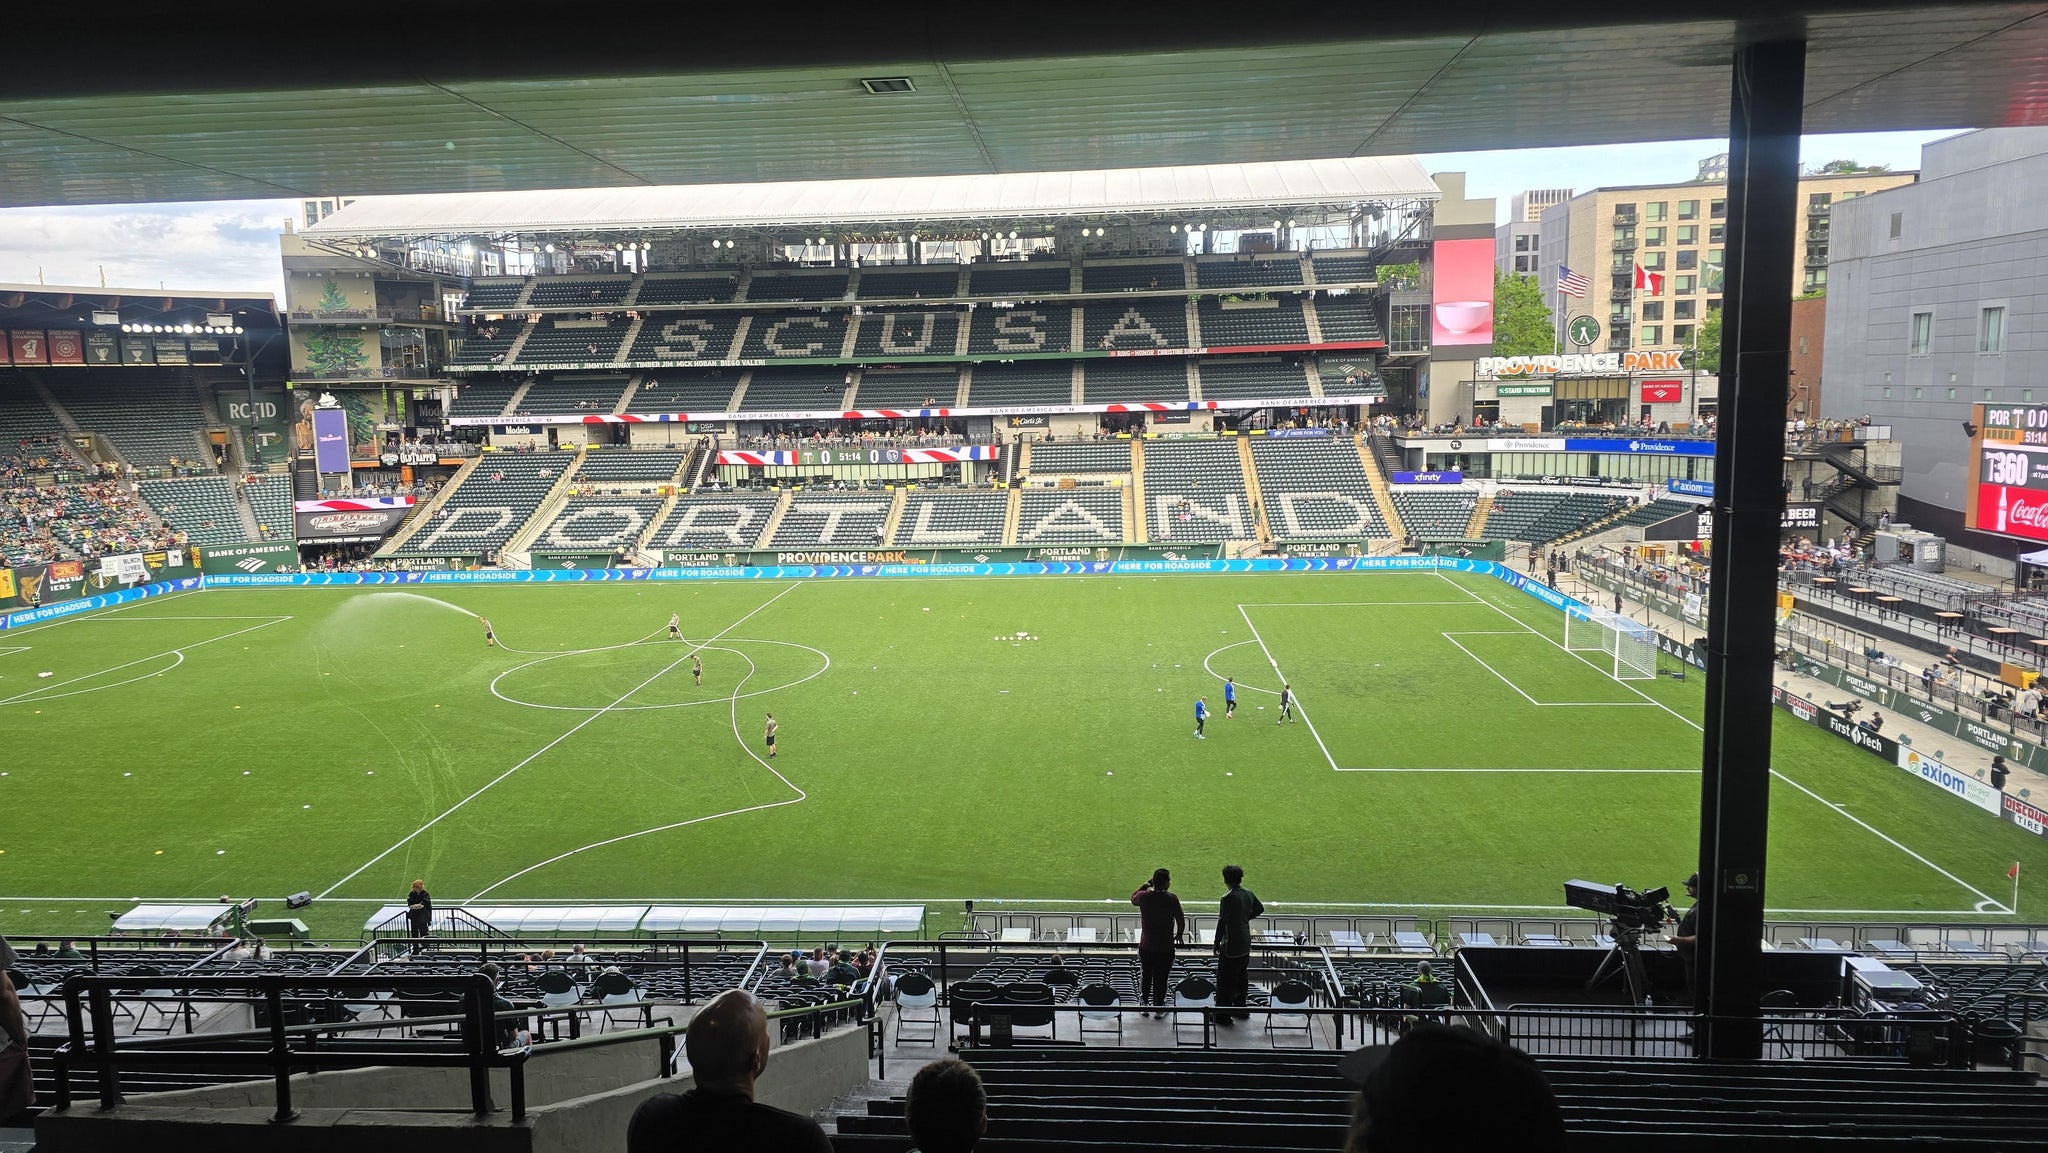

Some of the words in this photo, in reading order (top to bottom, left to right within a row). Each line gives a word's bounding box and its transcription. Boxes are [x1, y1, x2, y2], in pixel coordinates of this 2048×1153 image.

[1478, 353, 1620, 376] PROVIDENCE
[1623, 350, 1684, 372] PARK
[1989, 410, 2010, 426] POR
[2027, 409, 2037, 428] 0
[505, 426, 530, 434] Modelo
[2024, 431, 2048, 444] 51:14
[1514, 441, 1550, 449] Providence
[1640, 442, 1675, 452] Providence
[400, 453, 411, 463] OLD
[411, 453, 437, 463] TRAPPER
[820, 450, 831, 464] 0
[839, 452, 861, 461] 51:14
[870, 450, 879, 463] 0
[374, 472, 401, 482] TRAPPE
[1414, 473, 1441, 481] xfinity
[1540, 476, 1560, 484] Ford
[1680, 482, 1703, 493] axiom
[311, 516, 334, 524] OLD
[336, 513, 387, 522] TRAPPER
[1789, 508, 1816, 519] BEER
[208, 550, 234, 558] BANK
[249, 545, 291, 555] AMERICA
[1040, 547, 1091, 556] PORTLAND
[1286, 543, 1340, 552] PORTLAND
[1924, 545, 1939, 553] DIVE
[668, 553, 719, 562] PORTLAND
[656, 569, 678, 577] HERE
[701, 568, 744, 576] ROADSIDE
[930, 565, 975, 573] ROADSIDE
[207, 576, 231, 584] HERE
[251, 575, 294, 583] ROADSIDE
[454, 572, 471, 580] FOR
[473, 572, 516, 580] ROADSIDE
[14, 612, 36, 623] HERE
[36, 609, 53, 618] FOR
[54, 600, 93, 614] ROADSIDE
[1846, 675, 1877, 693] PORTLAND
[1852, 686, 1870, 697] TIMBERS
[1787, 694, 1817, 717] DISCOUNT
[1926, 704, 1943, 715] AMERICA
[1794, 707, 1808, 718] TIRE
[1830, 717, 1851, 737] First
[1861, 731, 1882, 752] Tech
[1968, 723, 2008, 746] PORTLAND
[1976, 736, 1999, 750] TIMBERS
[1922, 762, 1965, 794] axiom
[2018, 815, 2039, 832] TIRE
